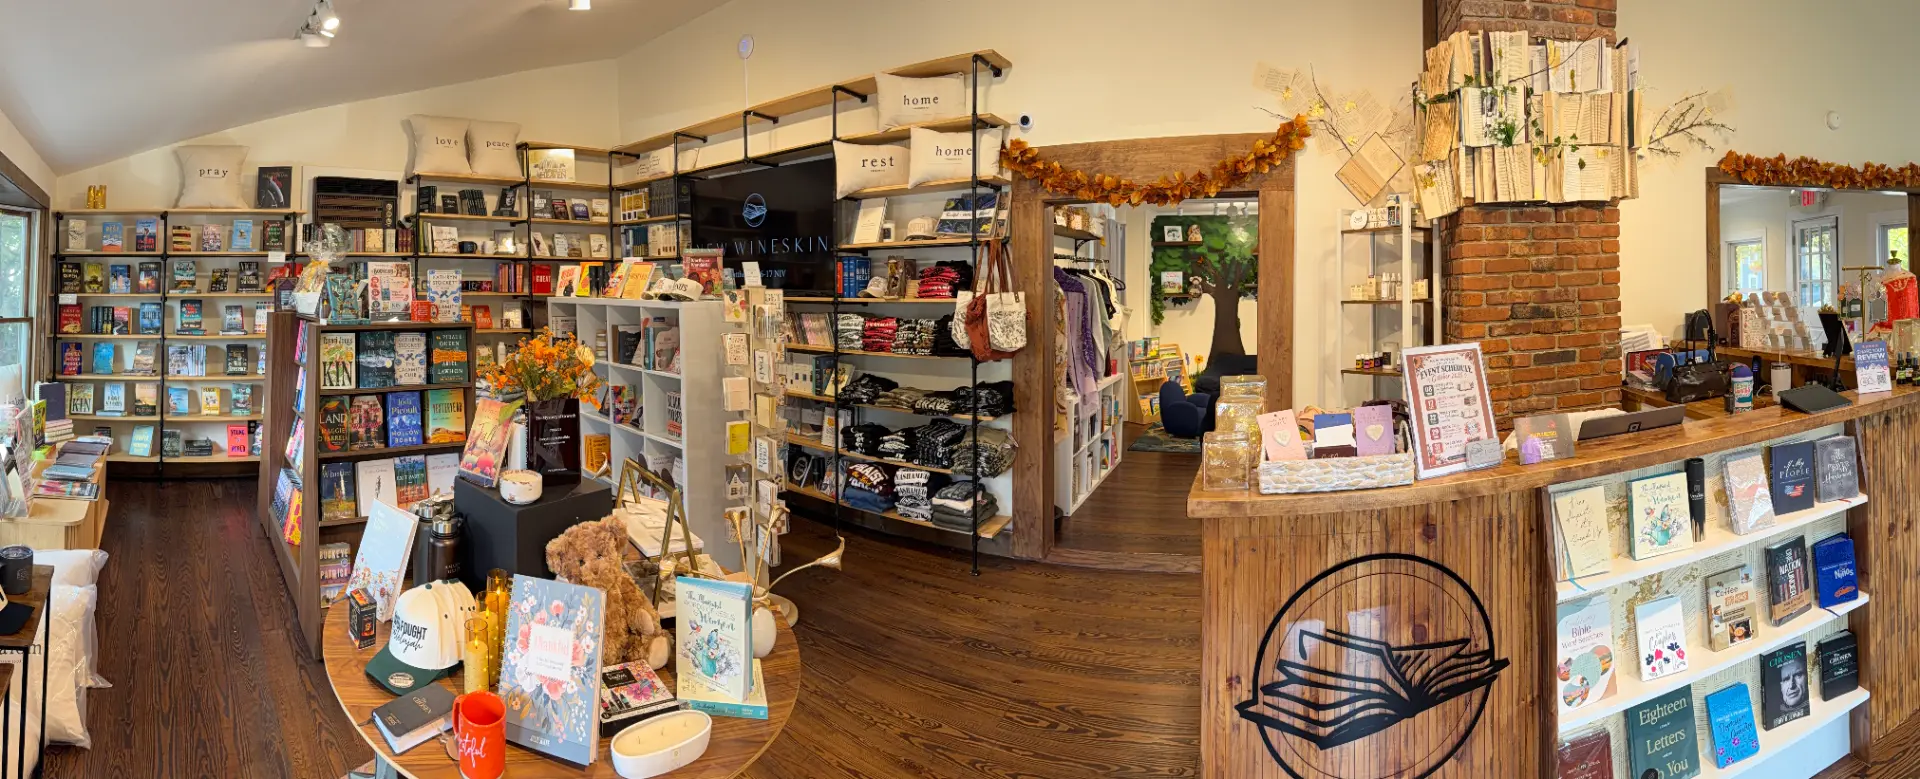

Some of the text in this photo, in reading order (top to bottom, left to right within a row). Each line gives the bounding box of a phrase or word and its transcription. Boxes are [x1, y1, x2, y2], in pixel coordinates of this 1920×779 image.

[903, 95, 939, 106] home
[435, 136, 459, 146] love
[486, 140, 510, 148] peace
[935, 146, 973, 157] home
[861, 156, 895, 168] rest
[198, 167, 229, 178] pray
[734, 235, 829, 256] WINESKIN
[774, 269, 787, 278] NIV
[1856, 352, 1885, 361] REVIEW
[322, 361, 353, 386] KIN
[1420, 364, 1473, 380] EVENT SCHEDULE
[915, 400, 951, 411] BRAVE
[319, 413, 346, 424] LAND
[1779, 558, 1801, 575] NATION
[1571, 625, 1592, 638] Bible
[1769, 650, 1803, 668] CHOSEN
[1639, 697, 1688, 726] Eighteen
[1646, 728, 1686, 755] Letters
[1666, 758, 1689, 777] You
